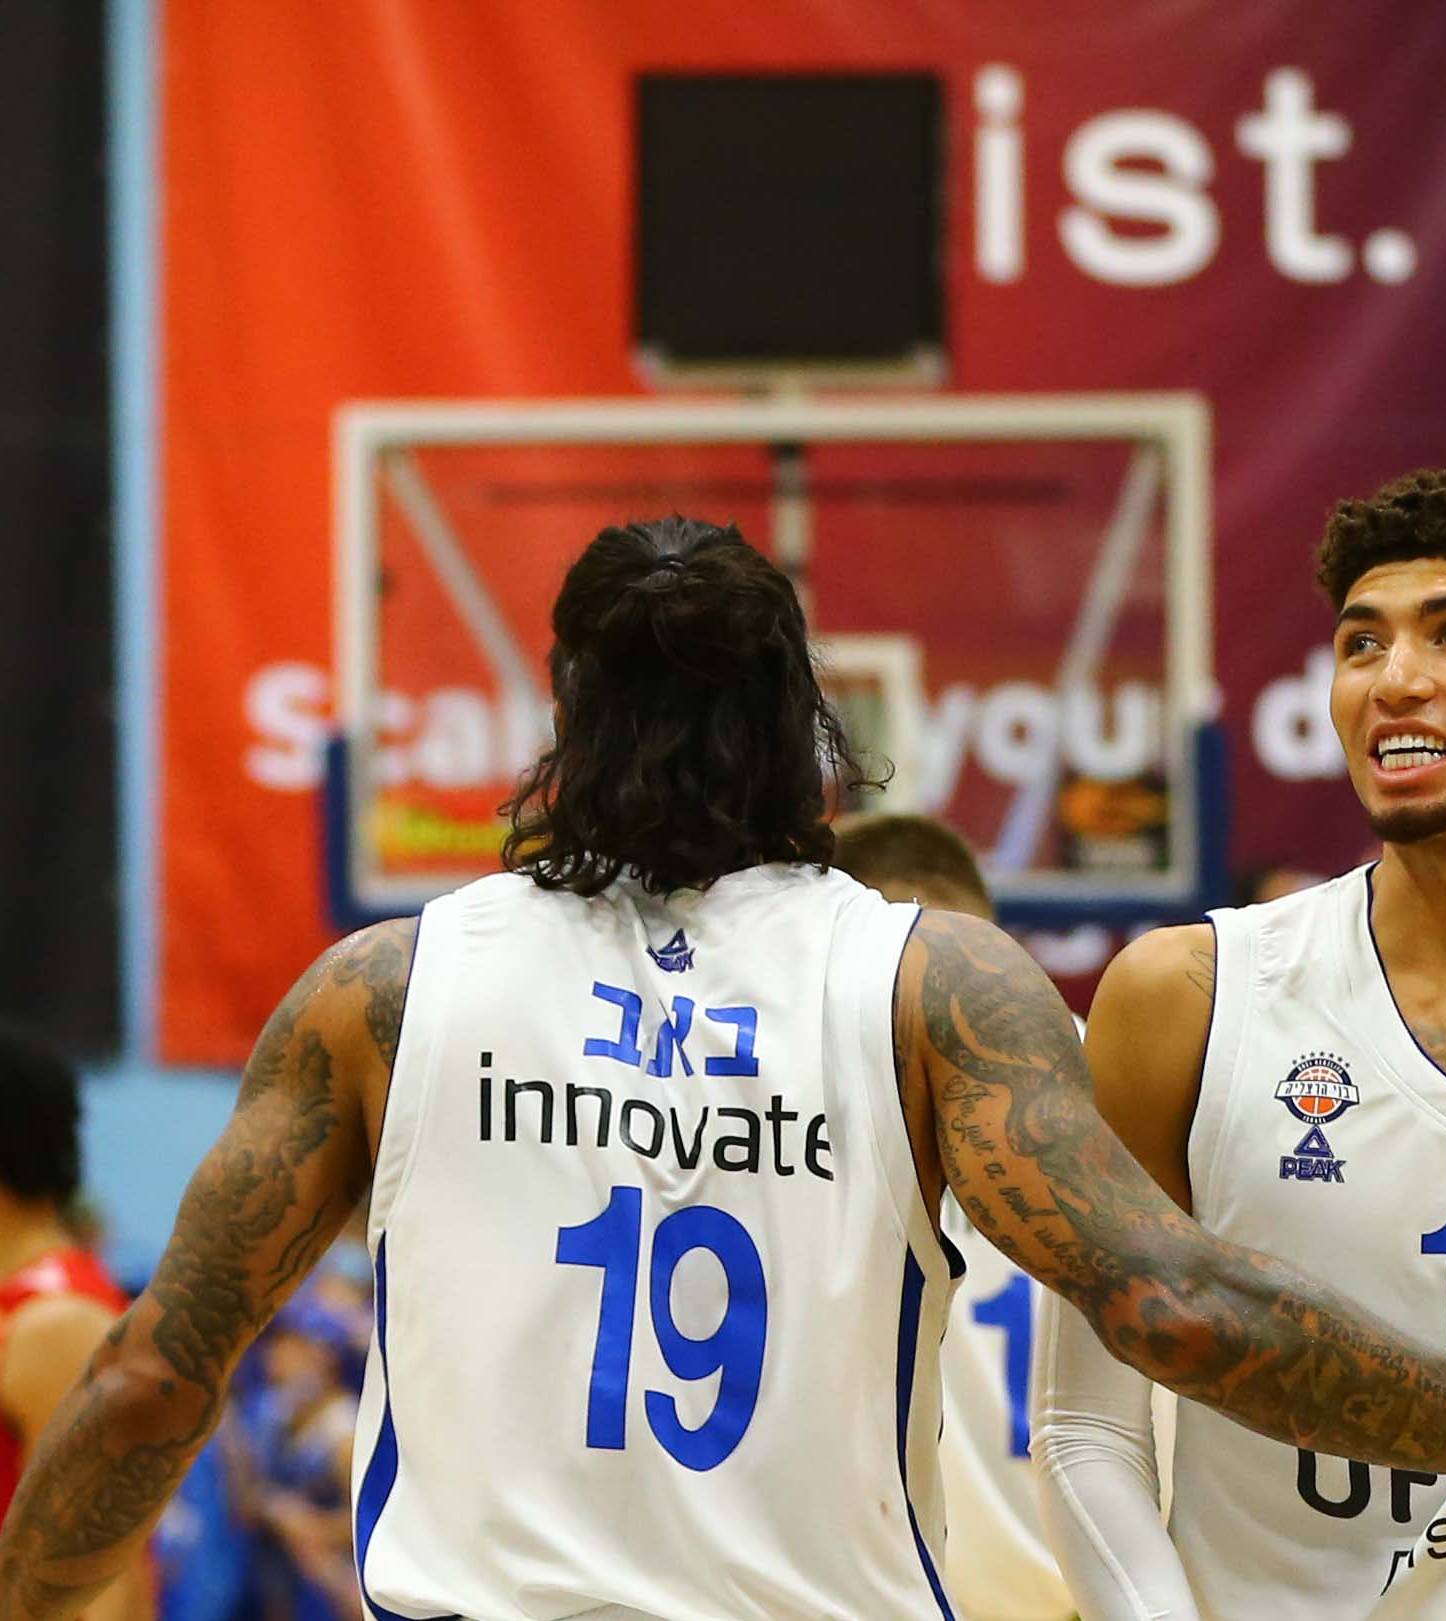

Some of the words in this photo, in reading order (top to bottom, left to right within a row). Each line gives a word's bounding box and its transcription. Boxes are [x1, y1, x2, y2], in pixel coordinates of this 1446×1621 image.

[478, 1051, 834, 1181] innovate
[1279, 1156, 1347, 1183] PEAK
[555, 1185, 768, 1472] 19
